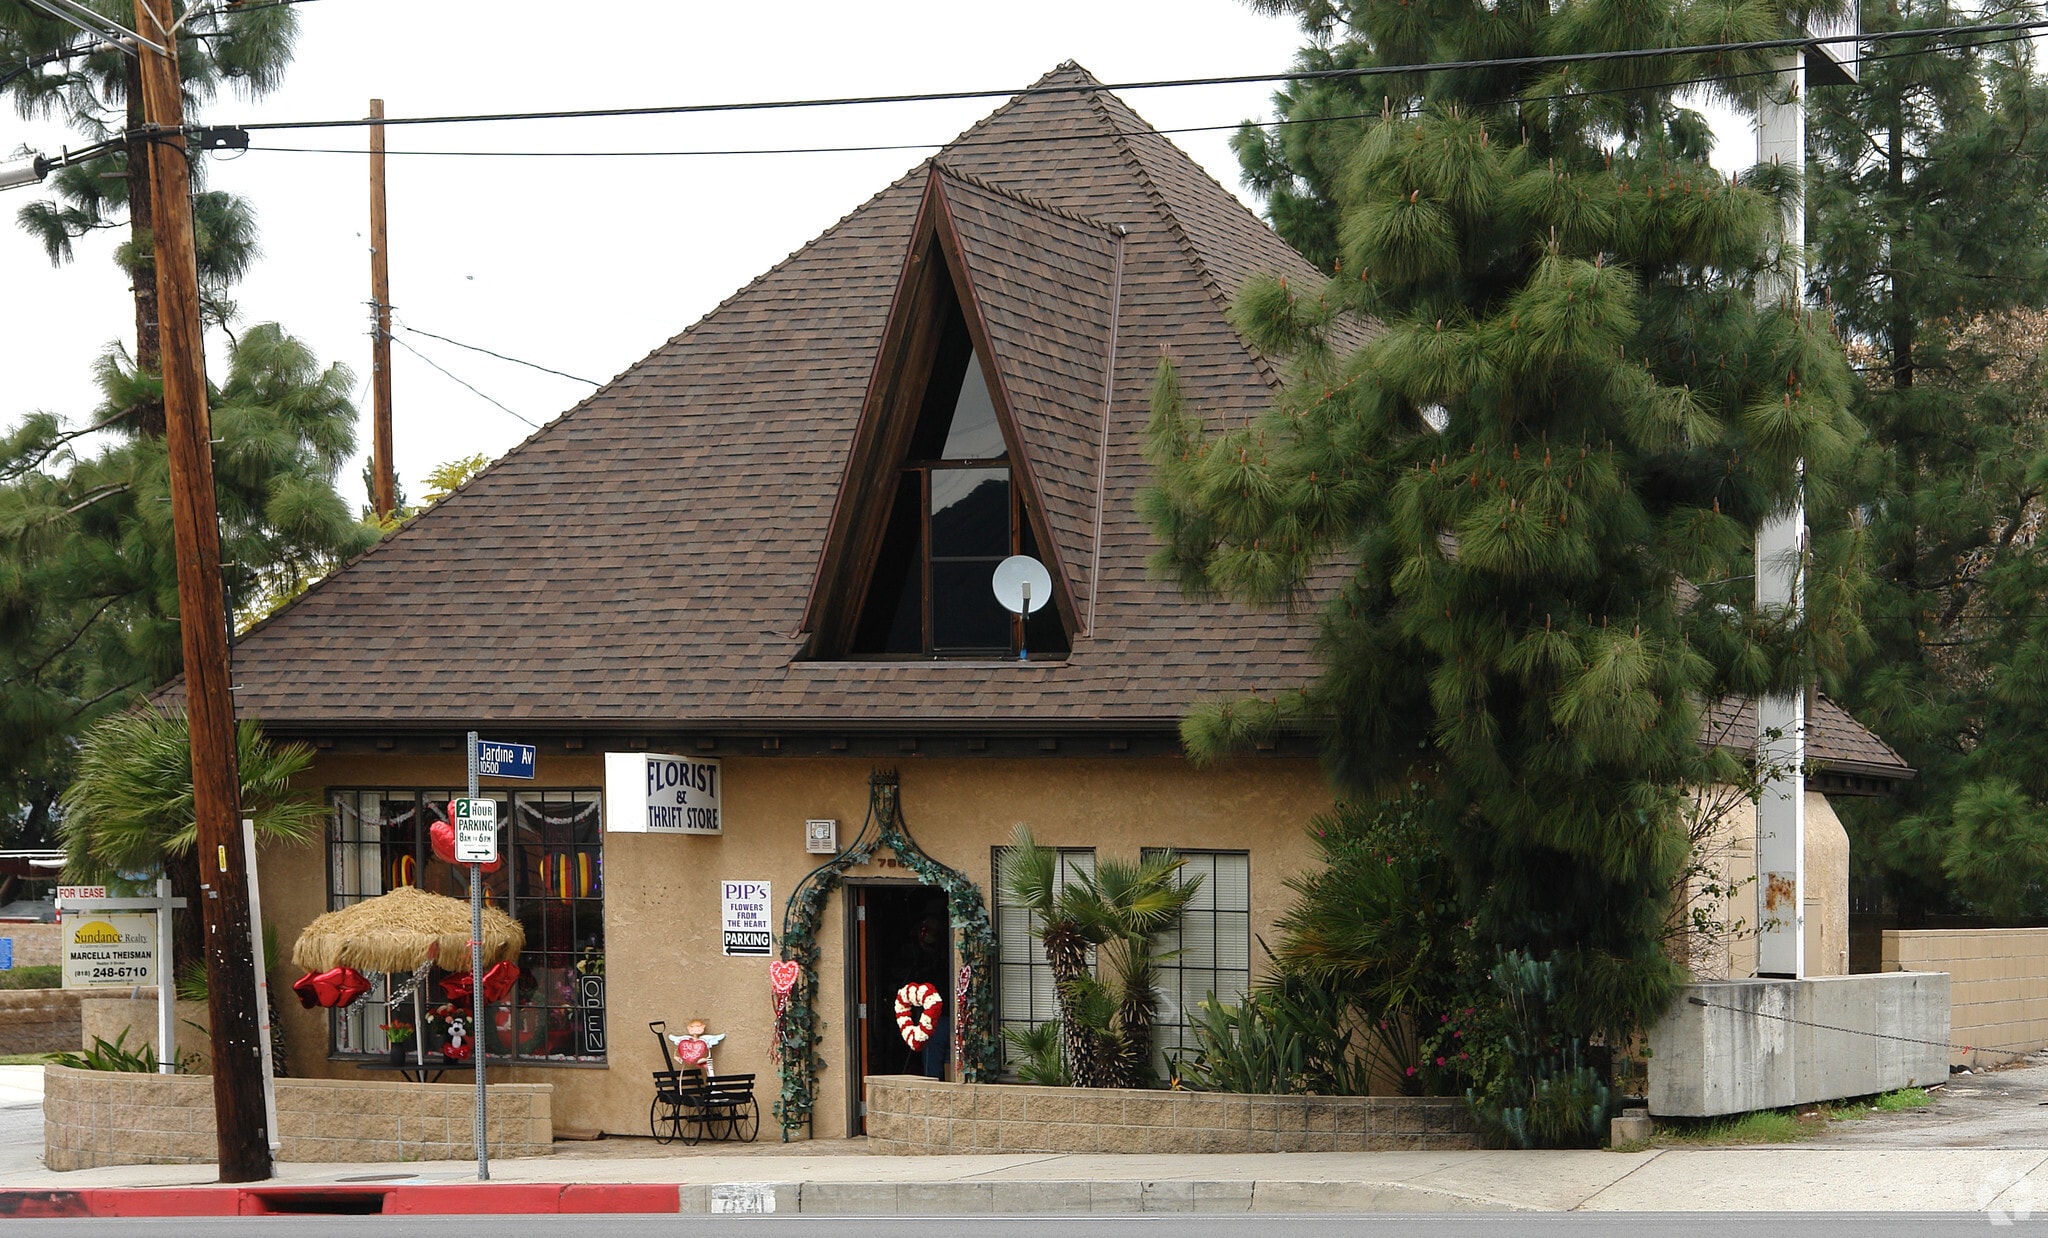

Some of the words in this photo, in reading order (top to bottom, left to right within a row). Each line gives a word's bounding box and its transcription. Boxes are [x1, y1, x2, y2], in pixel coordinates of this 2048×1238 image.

[480, 744, 513, 763] Jardine
[521, 748, 532, 764] Av
[480, 761, 499, 773] 10500
[647, 762, 716, 798] FLORIST
[676, 790, 687, 804] &
[459, 801, 468, 816] 2
[472, 806, 492, 817] HOUR
[648, 805, 682, 828] THRIFT
[687, 807, 718, 829] STORE
[458, 819, 494, 832] PARKING
[59, 888, 76, 898] FOR
[79, 888, 105, 898] LEASE
[730, 903, 763, 911] FLOWERS
[727, 920, 741, 928] THE
[743, 920, 767, 928] HEART
[74, 930, 123, 944] Sundance
[125, 933, 148, 944] Realty
[725, 932, 769, 946] PARKING
[70, 952, 110, 960] MARCELLA
[112, 951, 152, 959] THEISMAN
[93, 967, 147, 978] 248-6710
[584, 980, 603, 1048] OPEN
